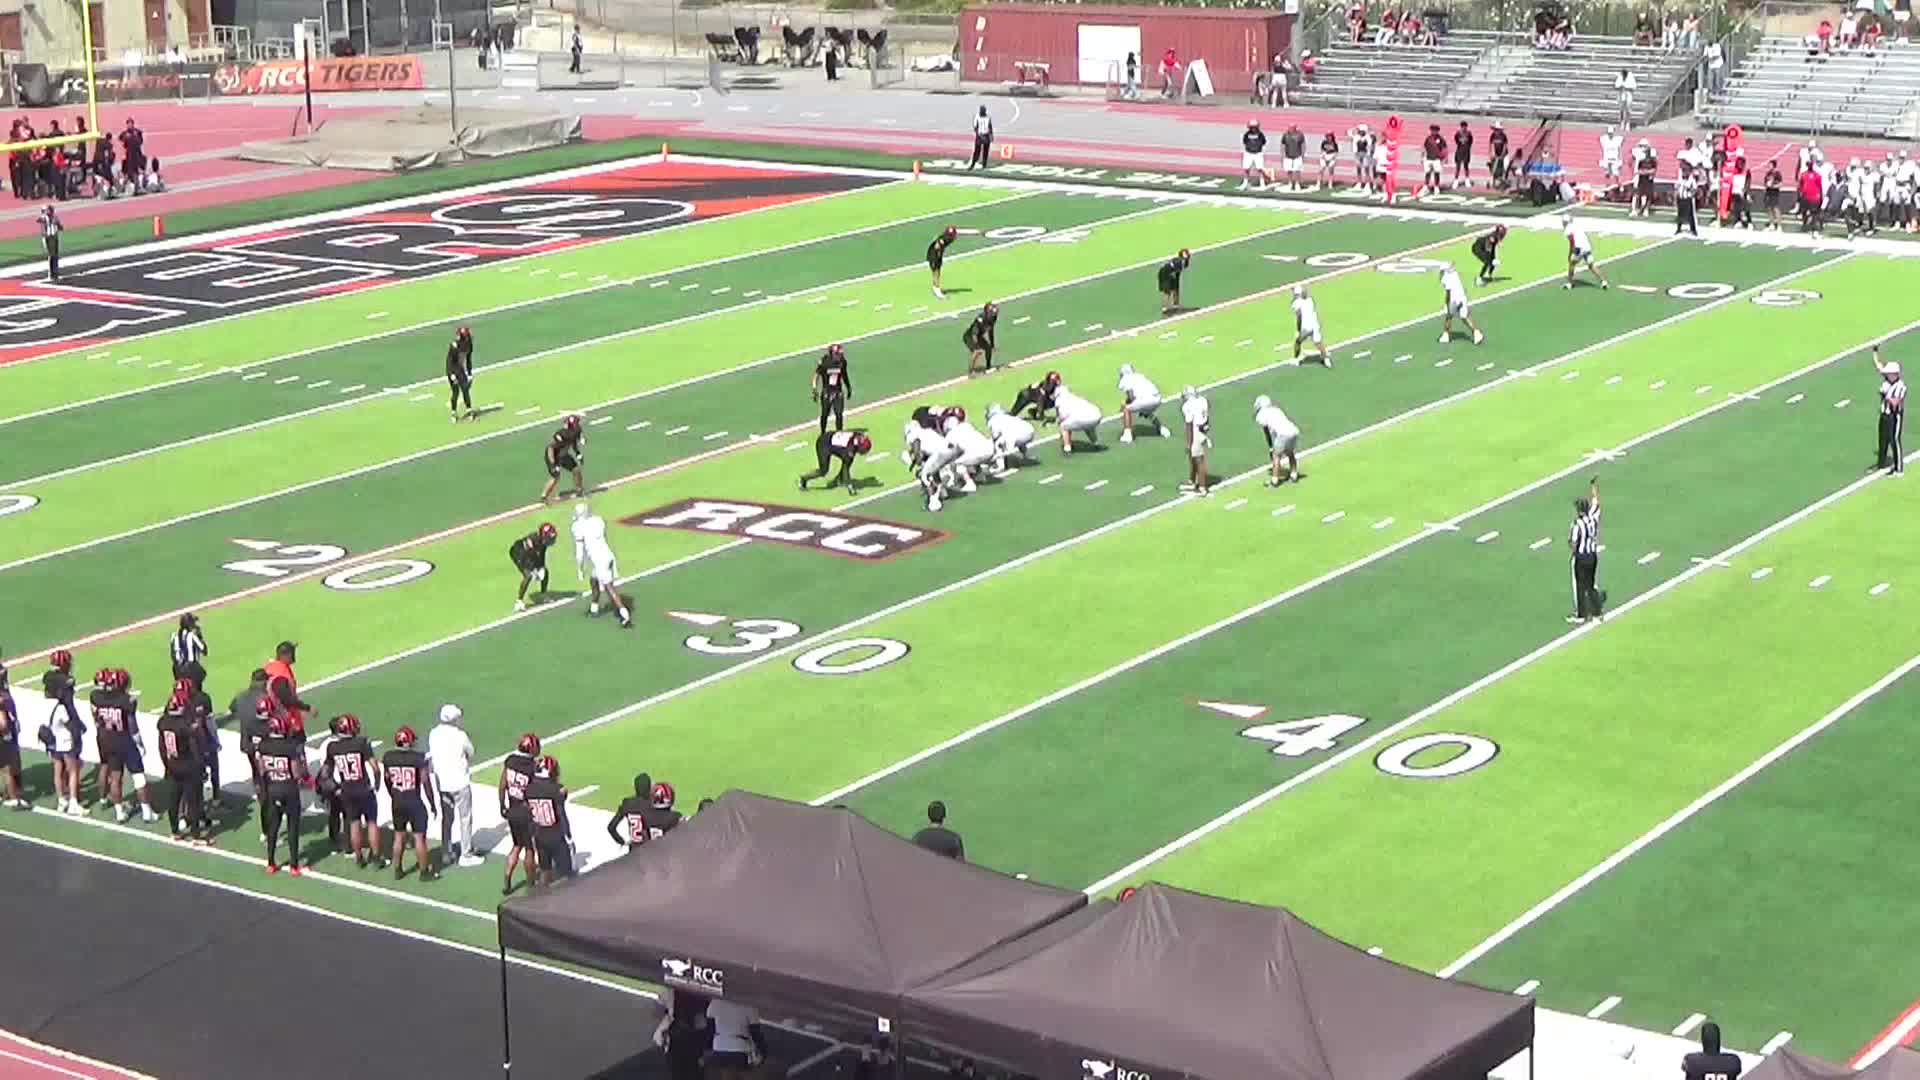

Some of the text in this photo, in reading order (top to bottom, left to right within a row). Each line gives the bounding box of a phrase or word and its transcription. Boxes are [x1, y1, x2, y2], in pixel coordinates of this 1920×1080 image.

[321, 62, 412, 83] TIGERS
[642, 500, 926, 556] RCC
[222, 542, 434, 591] 20
[684, 617, 911, 676] 30
[1240, 712, 1500, 778] 40
[693, 965, 724, 985] RCC
